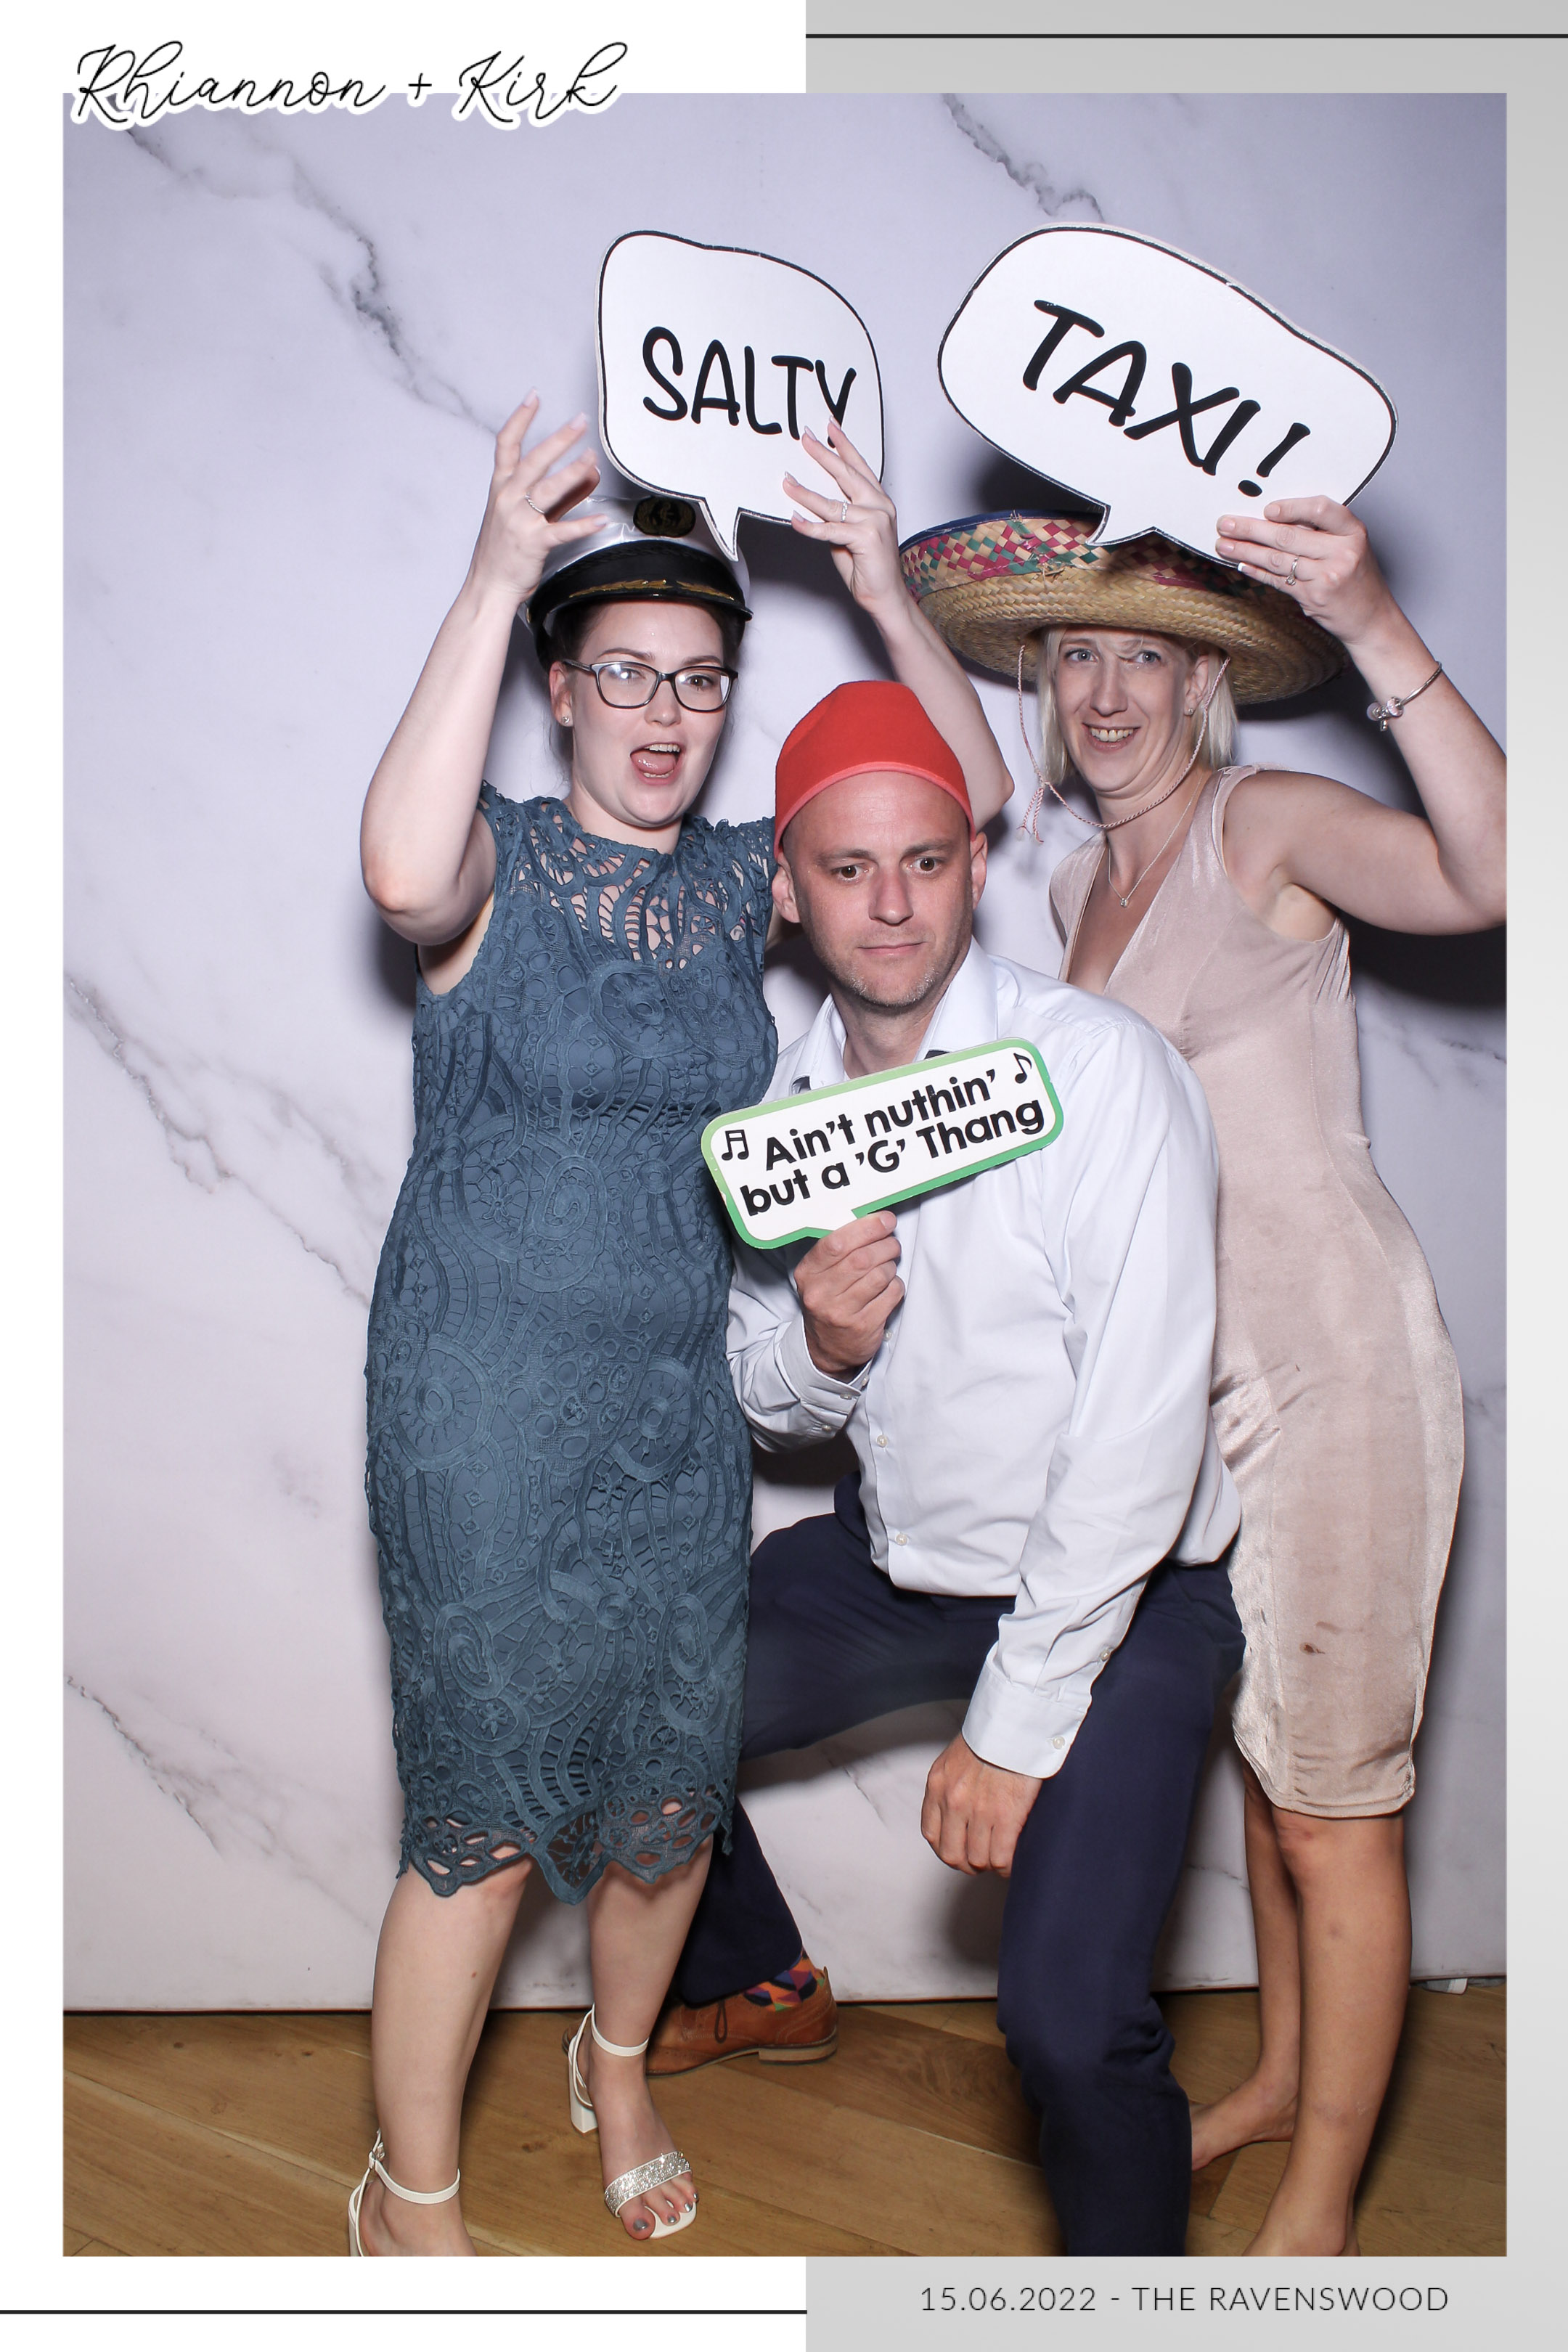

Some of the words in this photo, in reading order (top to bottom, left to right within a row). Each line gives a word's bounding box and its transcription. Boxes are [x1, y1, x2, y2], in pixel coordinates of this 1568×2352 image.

[642, 326, 857, 449] SALTY
[1022, 299, 1311, 497] TAXI!
[739, 1169, 811, 1217] but
[821, 1161, 851, 1190] a
[855, 1138, 906, 1173] 'G'
[916, 1099, 1045, 1159] Thang
[765, 1113, 856, 1172] Ain't
[864, 1069, 996, 1138] nuthin'
